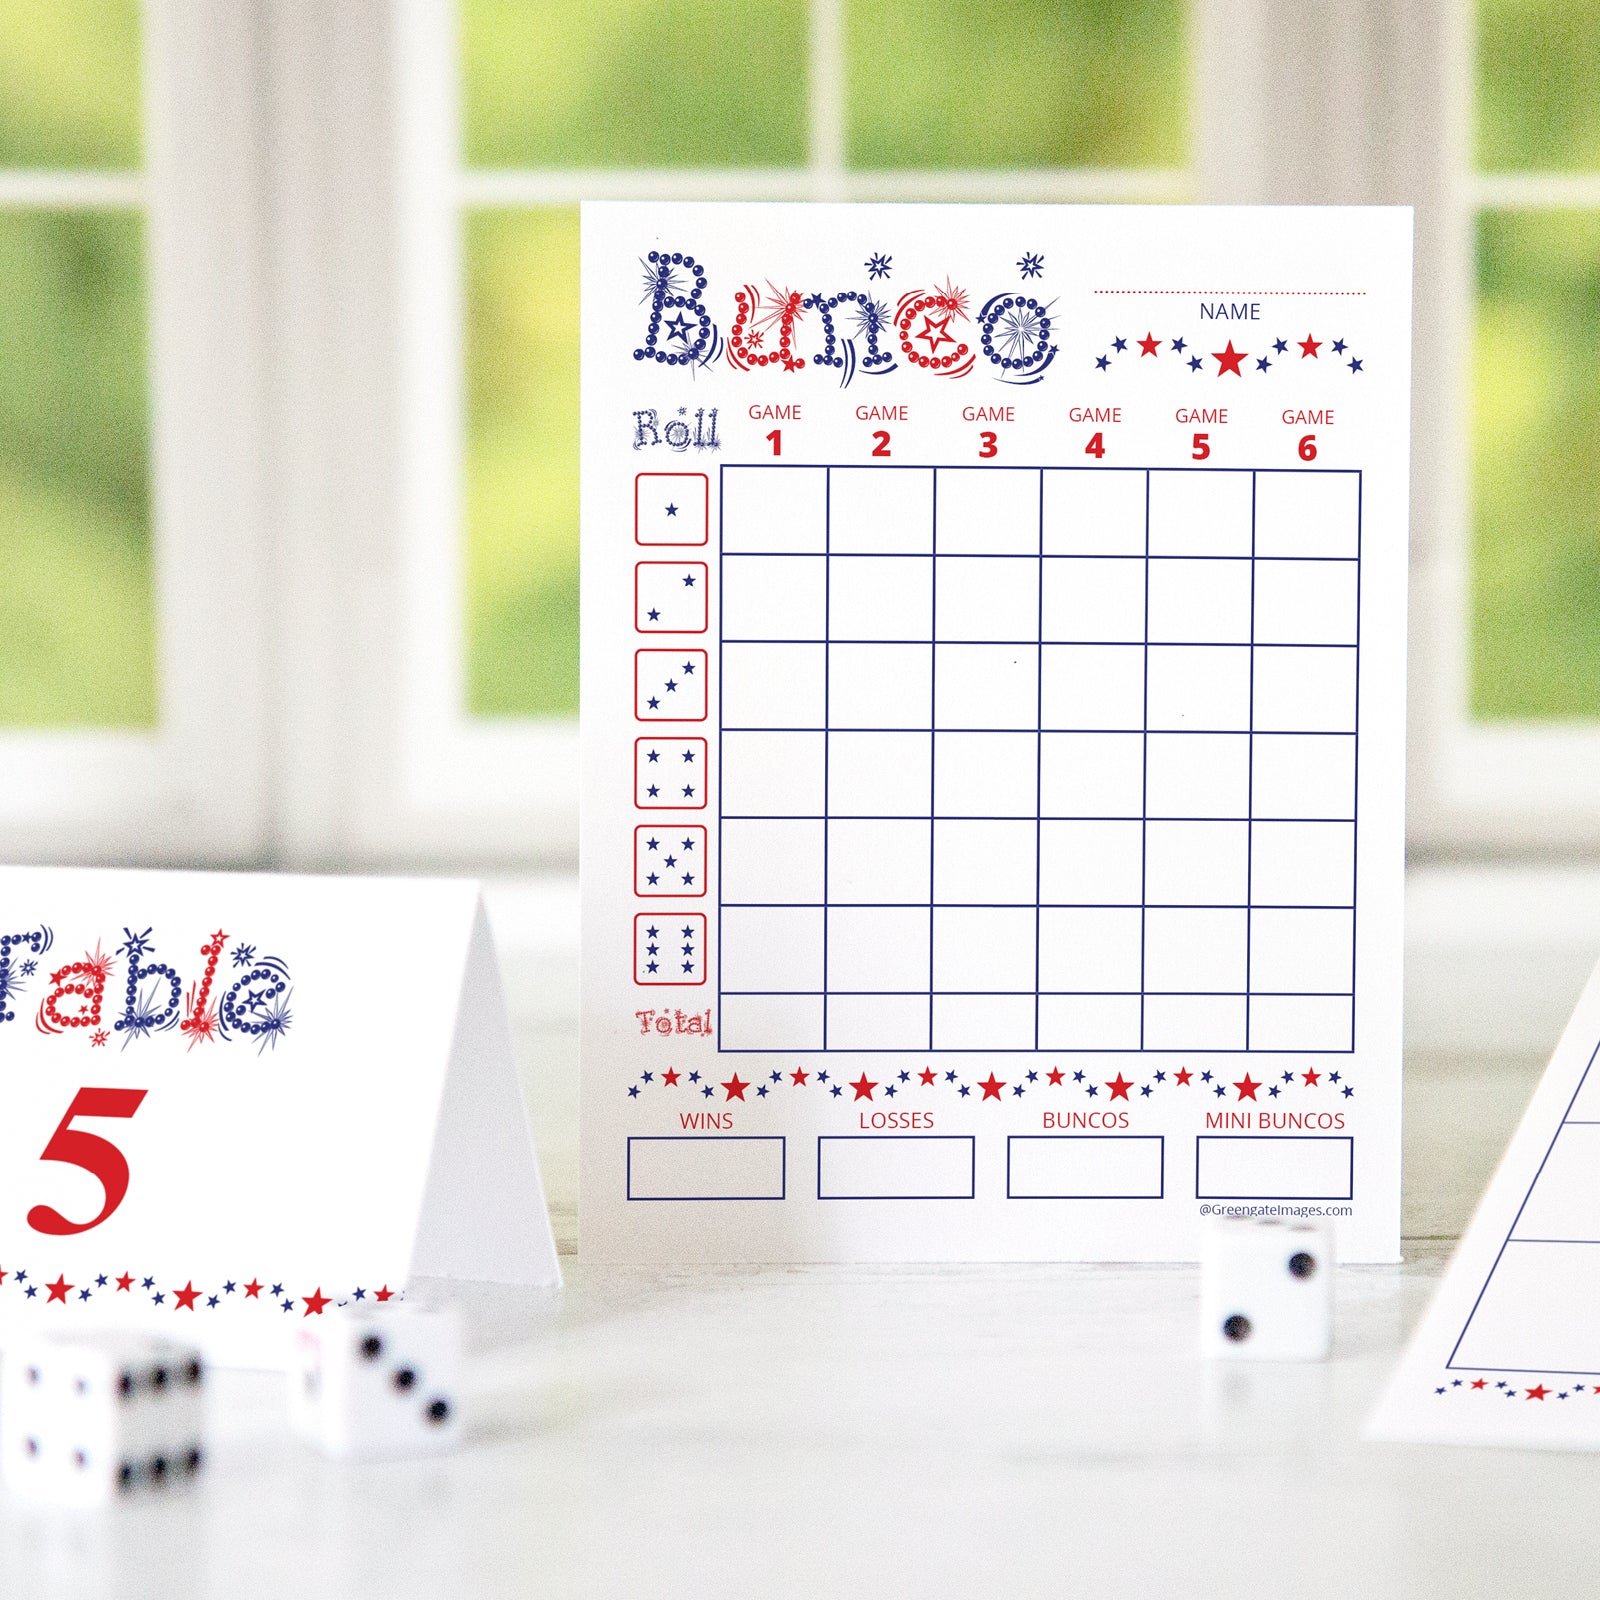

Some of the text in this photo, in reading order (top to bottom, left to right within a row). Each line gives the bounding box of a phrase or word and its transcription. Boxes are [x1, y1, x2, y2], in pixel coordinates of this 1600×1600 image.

[632, 249, 1061, 386] Bunco
[1199, 302, 1261, 320] NAME
[749, 404, 802, 420] GAME
[855, 405, 909, 421] GAME
[962, 406, 1016, 422] GAME
[1069, 407, 1122, 423] GAME
[1175, 408, 1228, 424] GAME
[1281, 409, 1335, 425] GAME
[632, 407, 722, 452] Roll
[765, 429, 783, 457] 1
[871, 429, 892, 458] 2
[978, 430, 999, 459] 3
[1084, 431, 1106, 459] 4
[1191, 432, 1212, 461] 5
[1297, 434, 1318, 462] 6
[635, 1008, 713, 1037] Total
[679, 1111, 734, 1130] WINS
[858, 1111, 935, 1130] LOSSES
[1042, 1111, 1130, 1130] BUNCOS
[1205, 1111, 1346, 1131] MINI BUNCOS
[26, 1086, 149, 1236] 5
[1199, 1203, 1353, 1218] @GreengateImages.com
